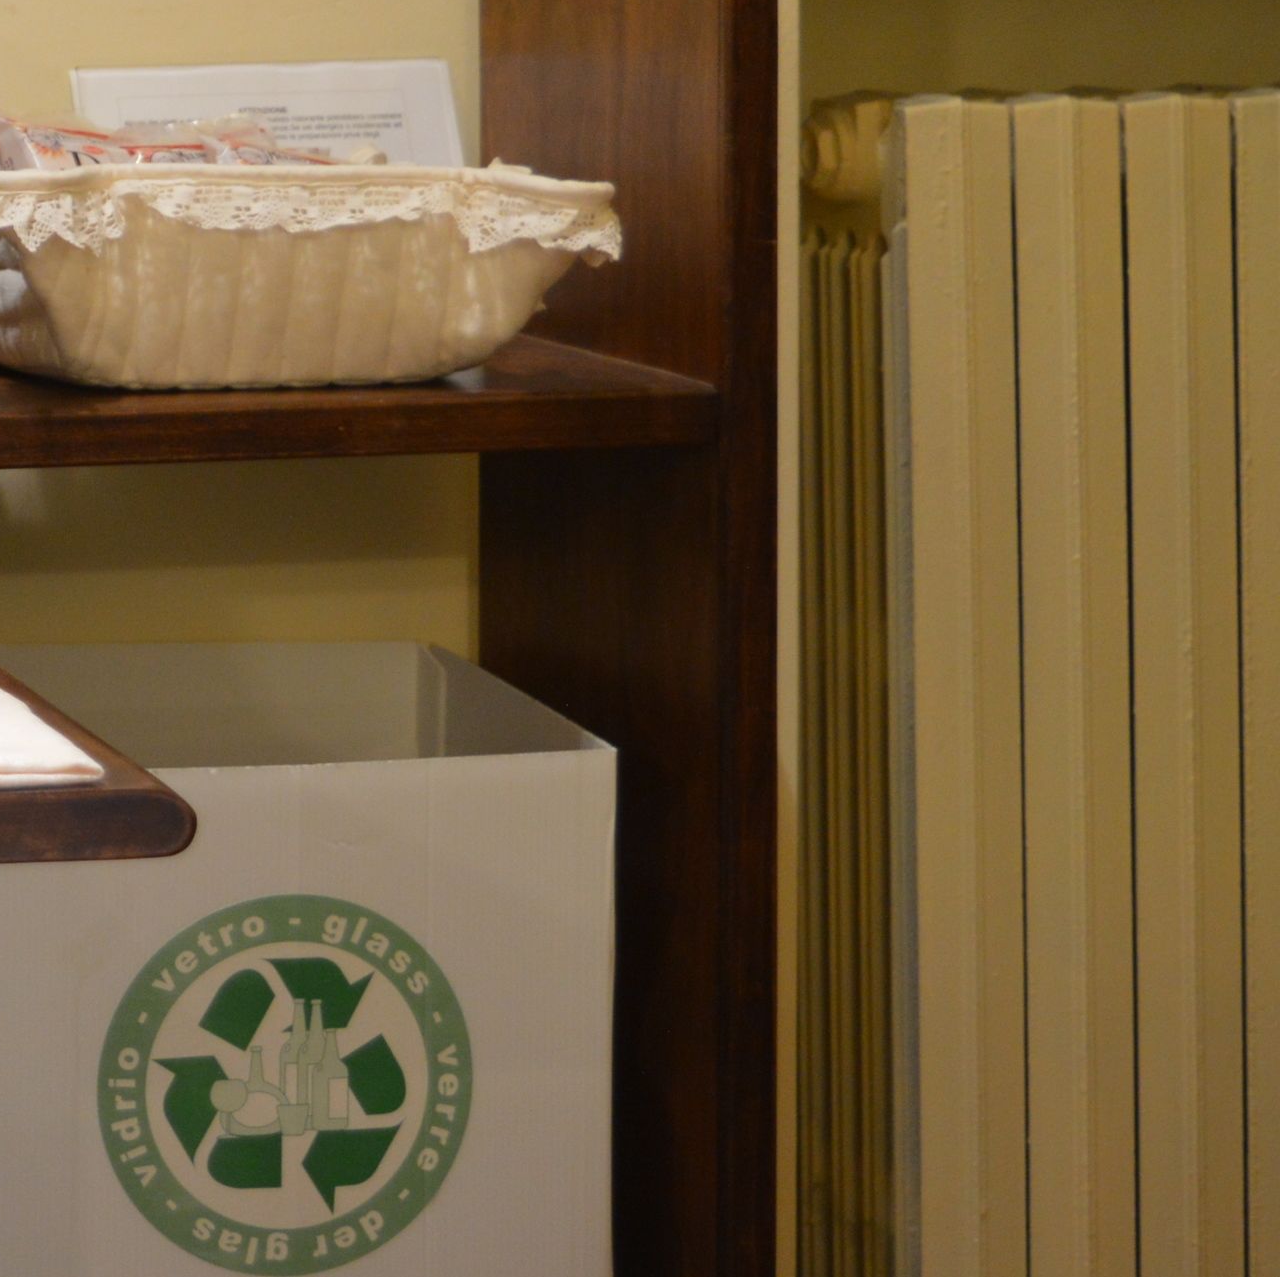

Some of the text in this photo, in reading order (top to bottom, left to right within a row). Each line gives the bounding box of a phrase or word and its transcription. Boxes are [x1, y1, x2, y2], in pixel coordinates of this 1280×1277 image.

[151, 913, 268, 995] vetro
[320, 913, 432, 996] glass
[107, 1046, 160, 1190] vidrio
[415, 1043, 461, 1174] verre
[191, 1208, 386, 1266] der glas
